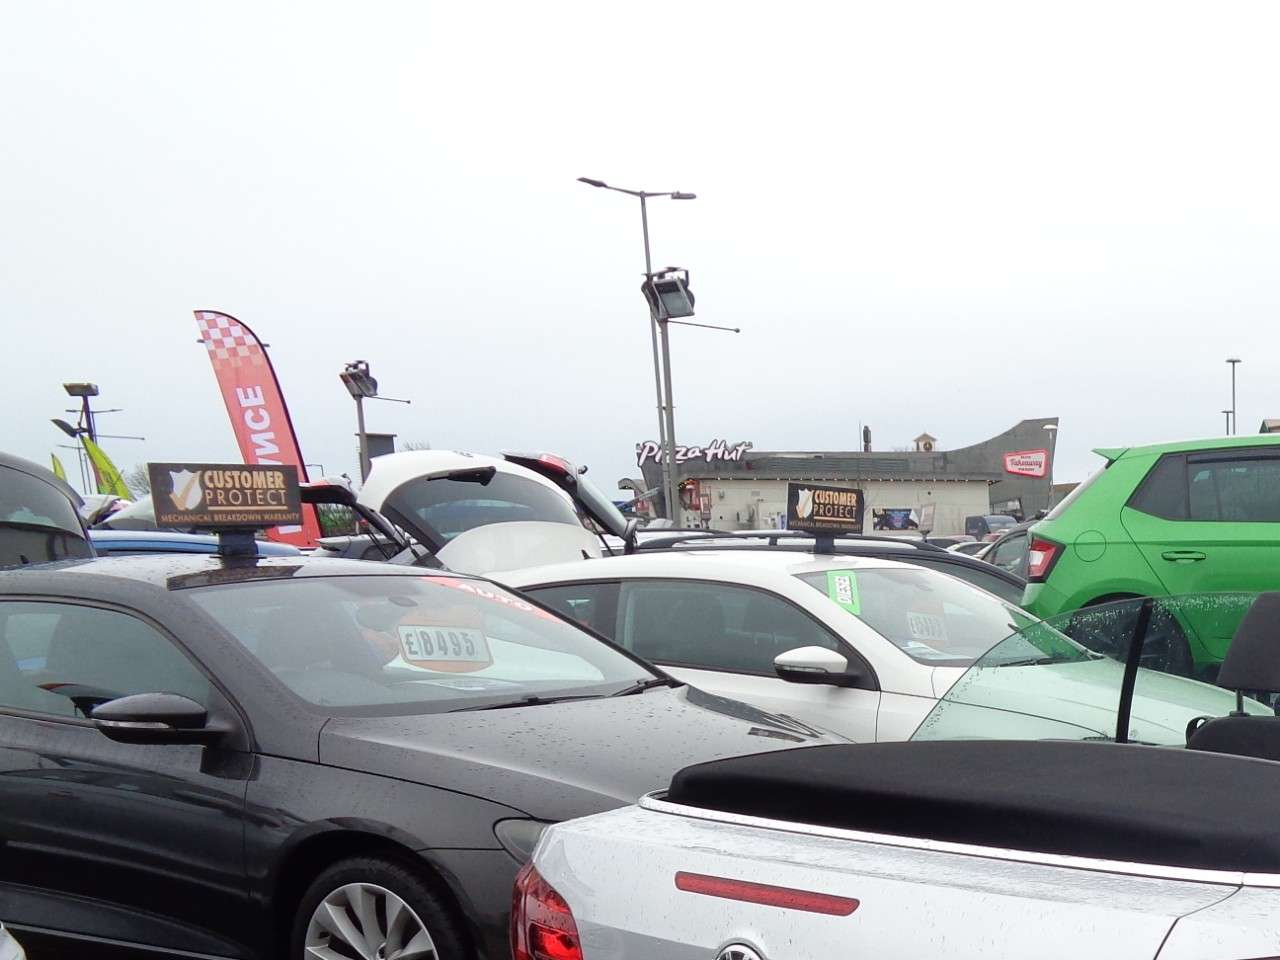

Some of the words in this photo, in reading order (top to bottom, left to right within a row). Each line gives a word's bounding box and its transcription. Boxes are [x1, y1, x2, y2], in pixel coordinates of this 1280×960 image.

[636, 441, 702, 467] Piza
[705, 439, 753, 462] Hut
[204, 470, 286, 489] CUSTOMER
[205, 490, 287, 505] PROTECT
[814, 490, 857, 507] CUSTOMER
[813, 504, 857, 518] PROTECT
